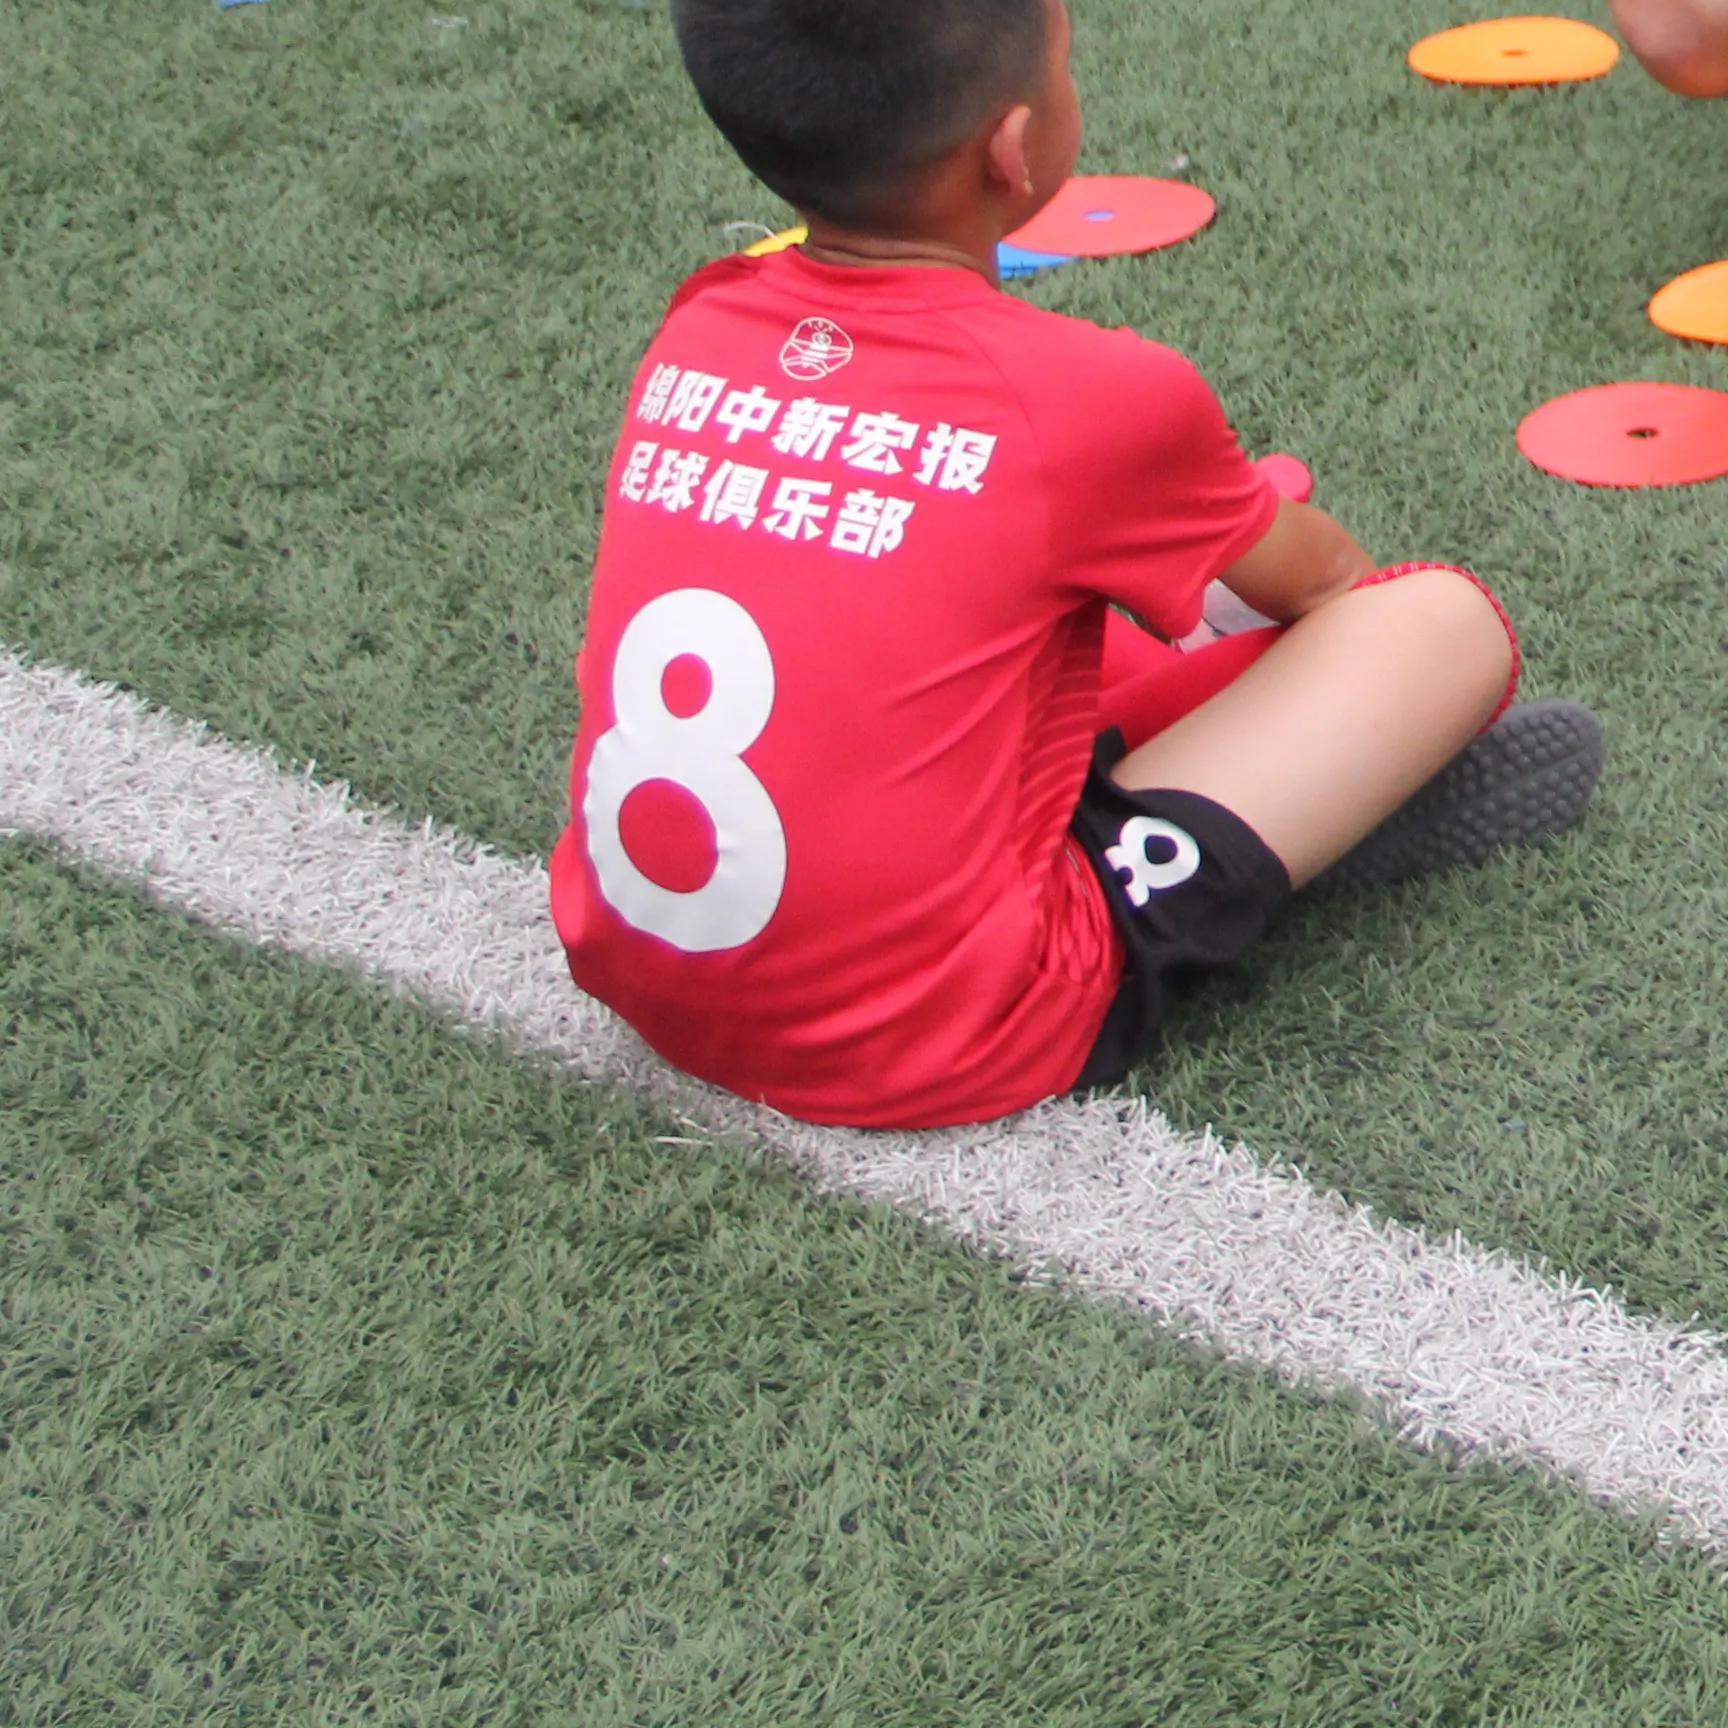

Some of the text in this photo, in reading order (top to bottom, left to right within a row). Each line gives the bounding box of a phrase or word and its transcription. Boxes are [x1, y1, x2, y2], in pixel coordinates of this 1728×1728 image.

[636, 362, 998, 495] 绵阳中新宏报
[619, 440, 916, 559] 足球俱乐部
[584, 588, 787, 953] 8
